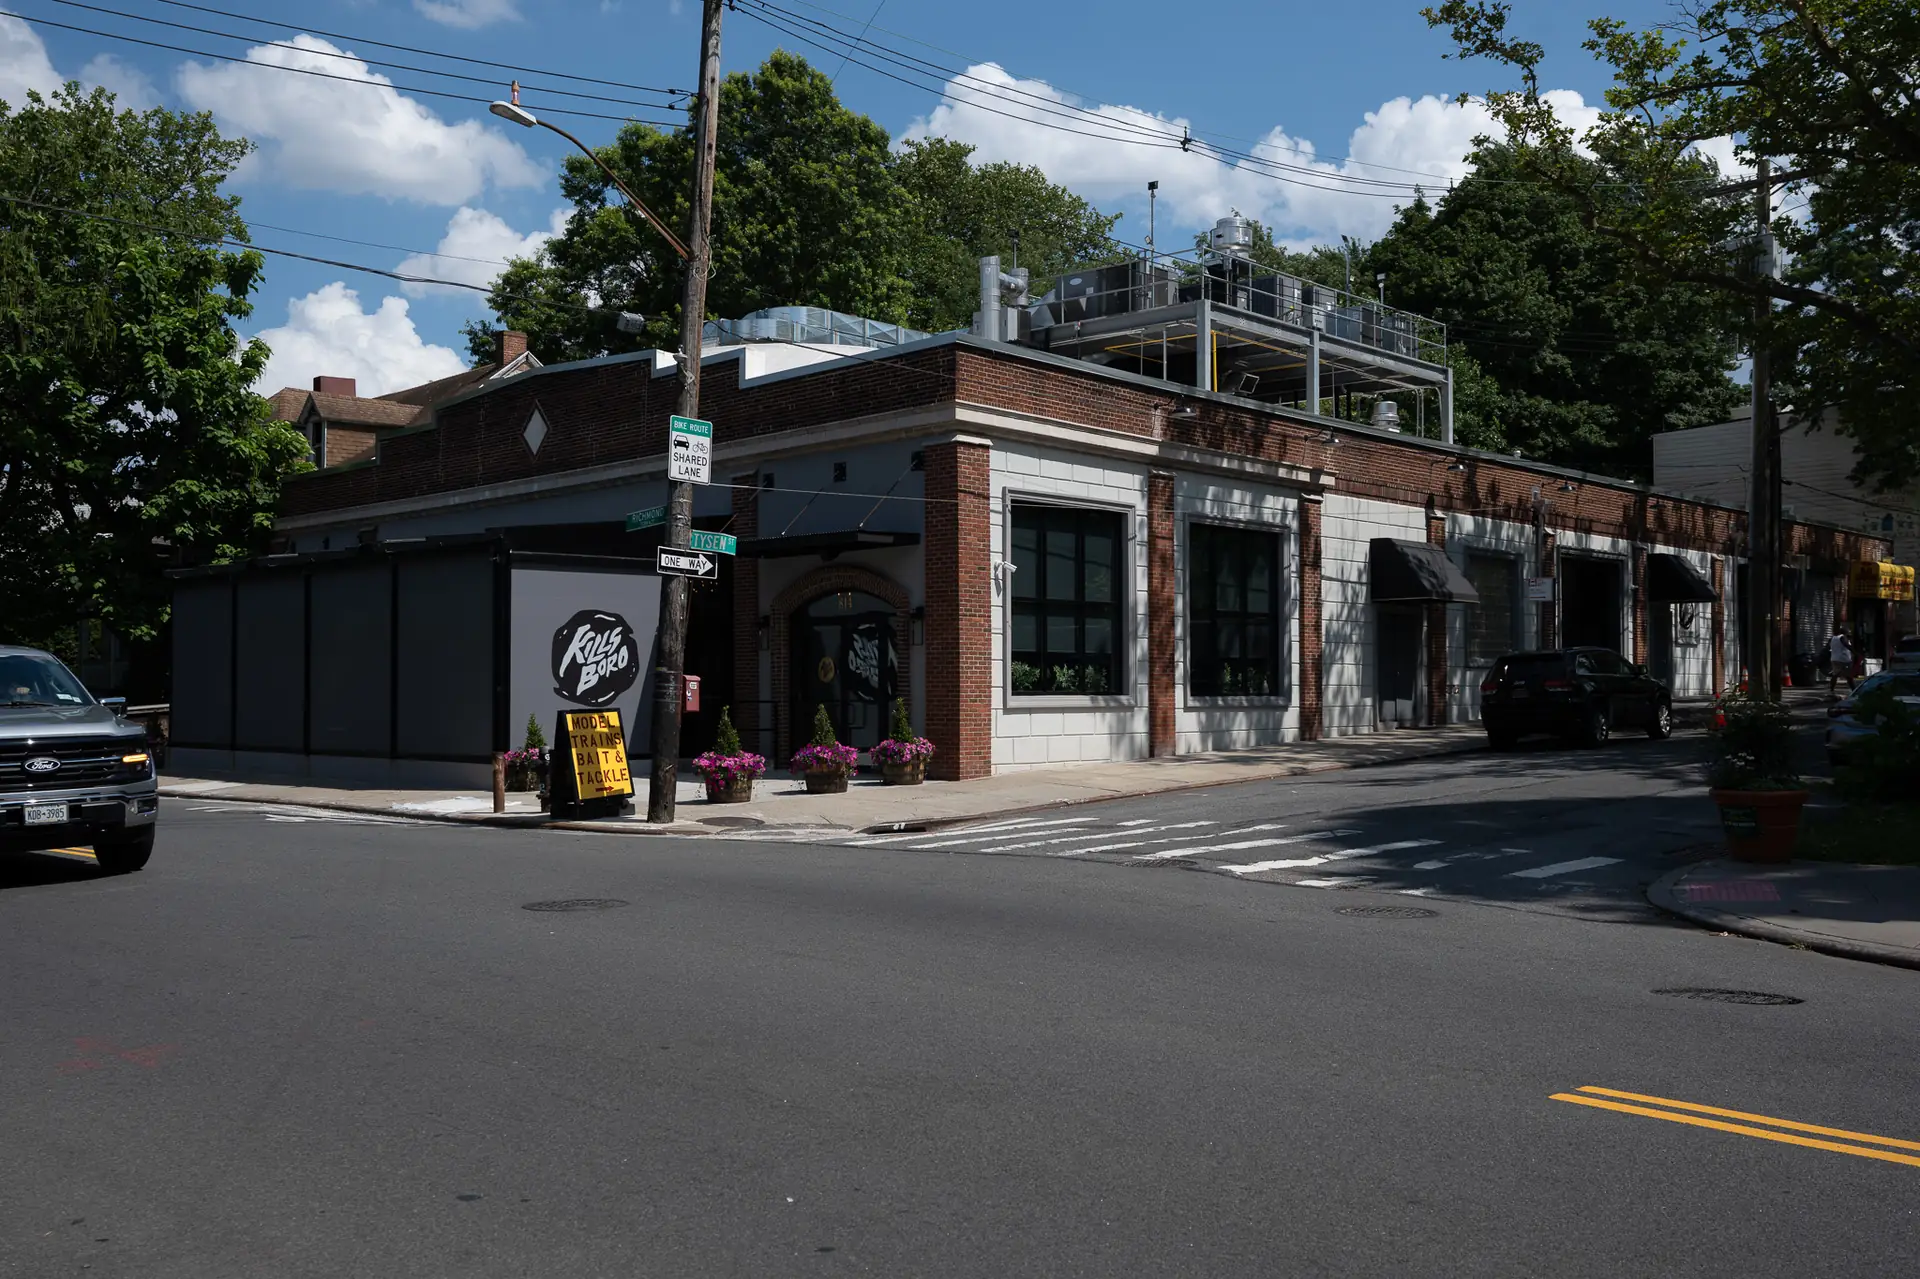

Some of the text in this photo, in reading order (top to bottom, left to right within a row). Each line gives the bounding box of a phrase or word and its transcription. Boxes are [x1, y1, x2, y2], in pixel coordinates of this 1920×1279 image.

[674, 420, 709, 434] BIKE ROUTE
[673, 452, 708, 467] SHARED
[678, 465, 702, 478] LANE
[632, 507, 665, 522] RICHMOND
[693, 533, 735, 551] TYSEN ST
[664, 555, 707, 570] ONE WAY
[559, 623, 623, 678] KILLS
[576, 645, 629, 696] BORO
[571, 714, 616, 730] MODEL
[571, 732, 622, 749] TRAINS
[31, 760, 54, 770] Ford
[576, 750, 624, 766] BAIT &
[577, 767, 629, 785] TACKLE
